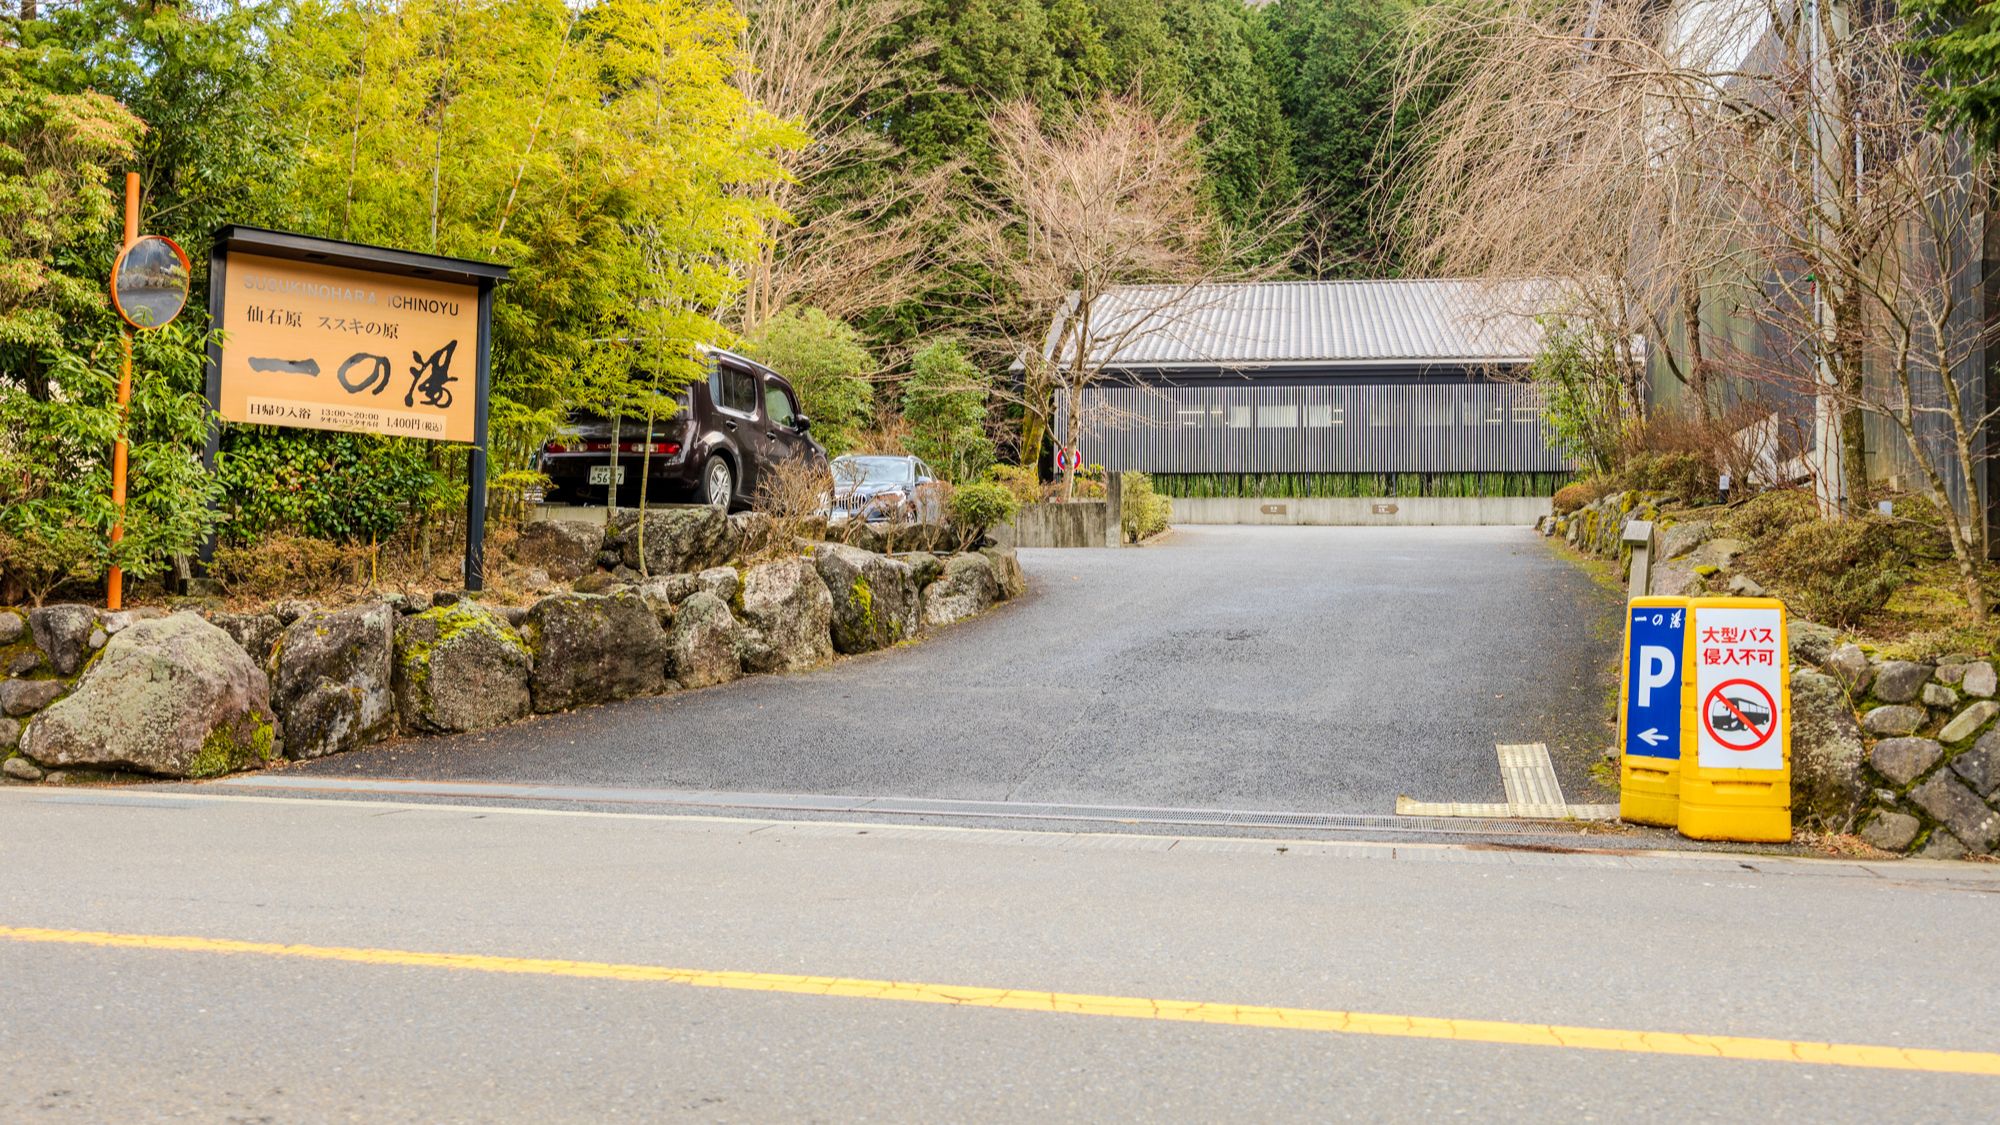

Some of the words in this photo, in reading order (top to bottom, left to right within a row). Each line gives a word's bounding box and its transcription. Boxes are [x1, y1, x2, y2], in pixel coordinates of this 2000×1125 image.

[244, 275, 377, 305] SUSUKINOHARA
[387, 295, 460, 317] ICHINOYU
[247, 305, 303, 328] 仙石原
[318, 316, 399, 340] ススキの原
[250, 403, 311, 420] 日帰り入浴
[597, 473, 622, 483] 567
[1702, 626, 1775, 644] 大型バス
[1703, 648, 1775, 666] 侵入不可
[1638, 645, 1676, 708] P
